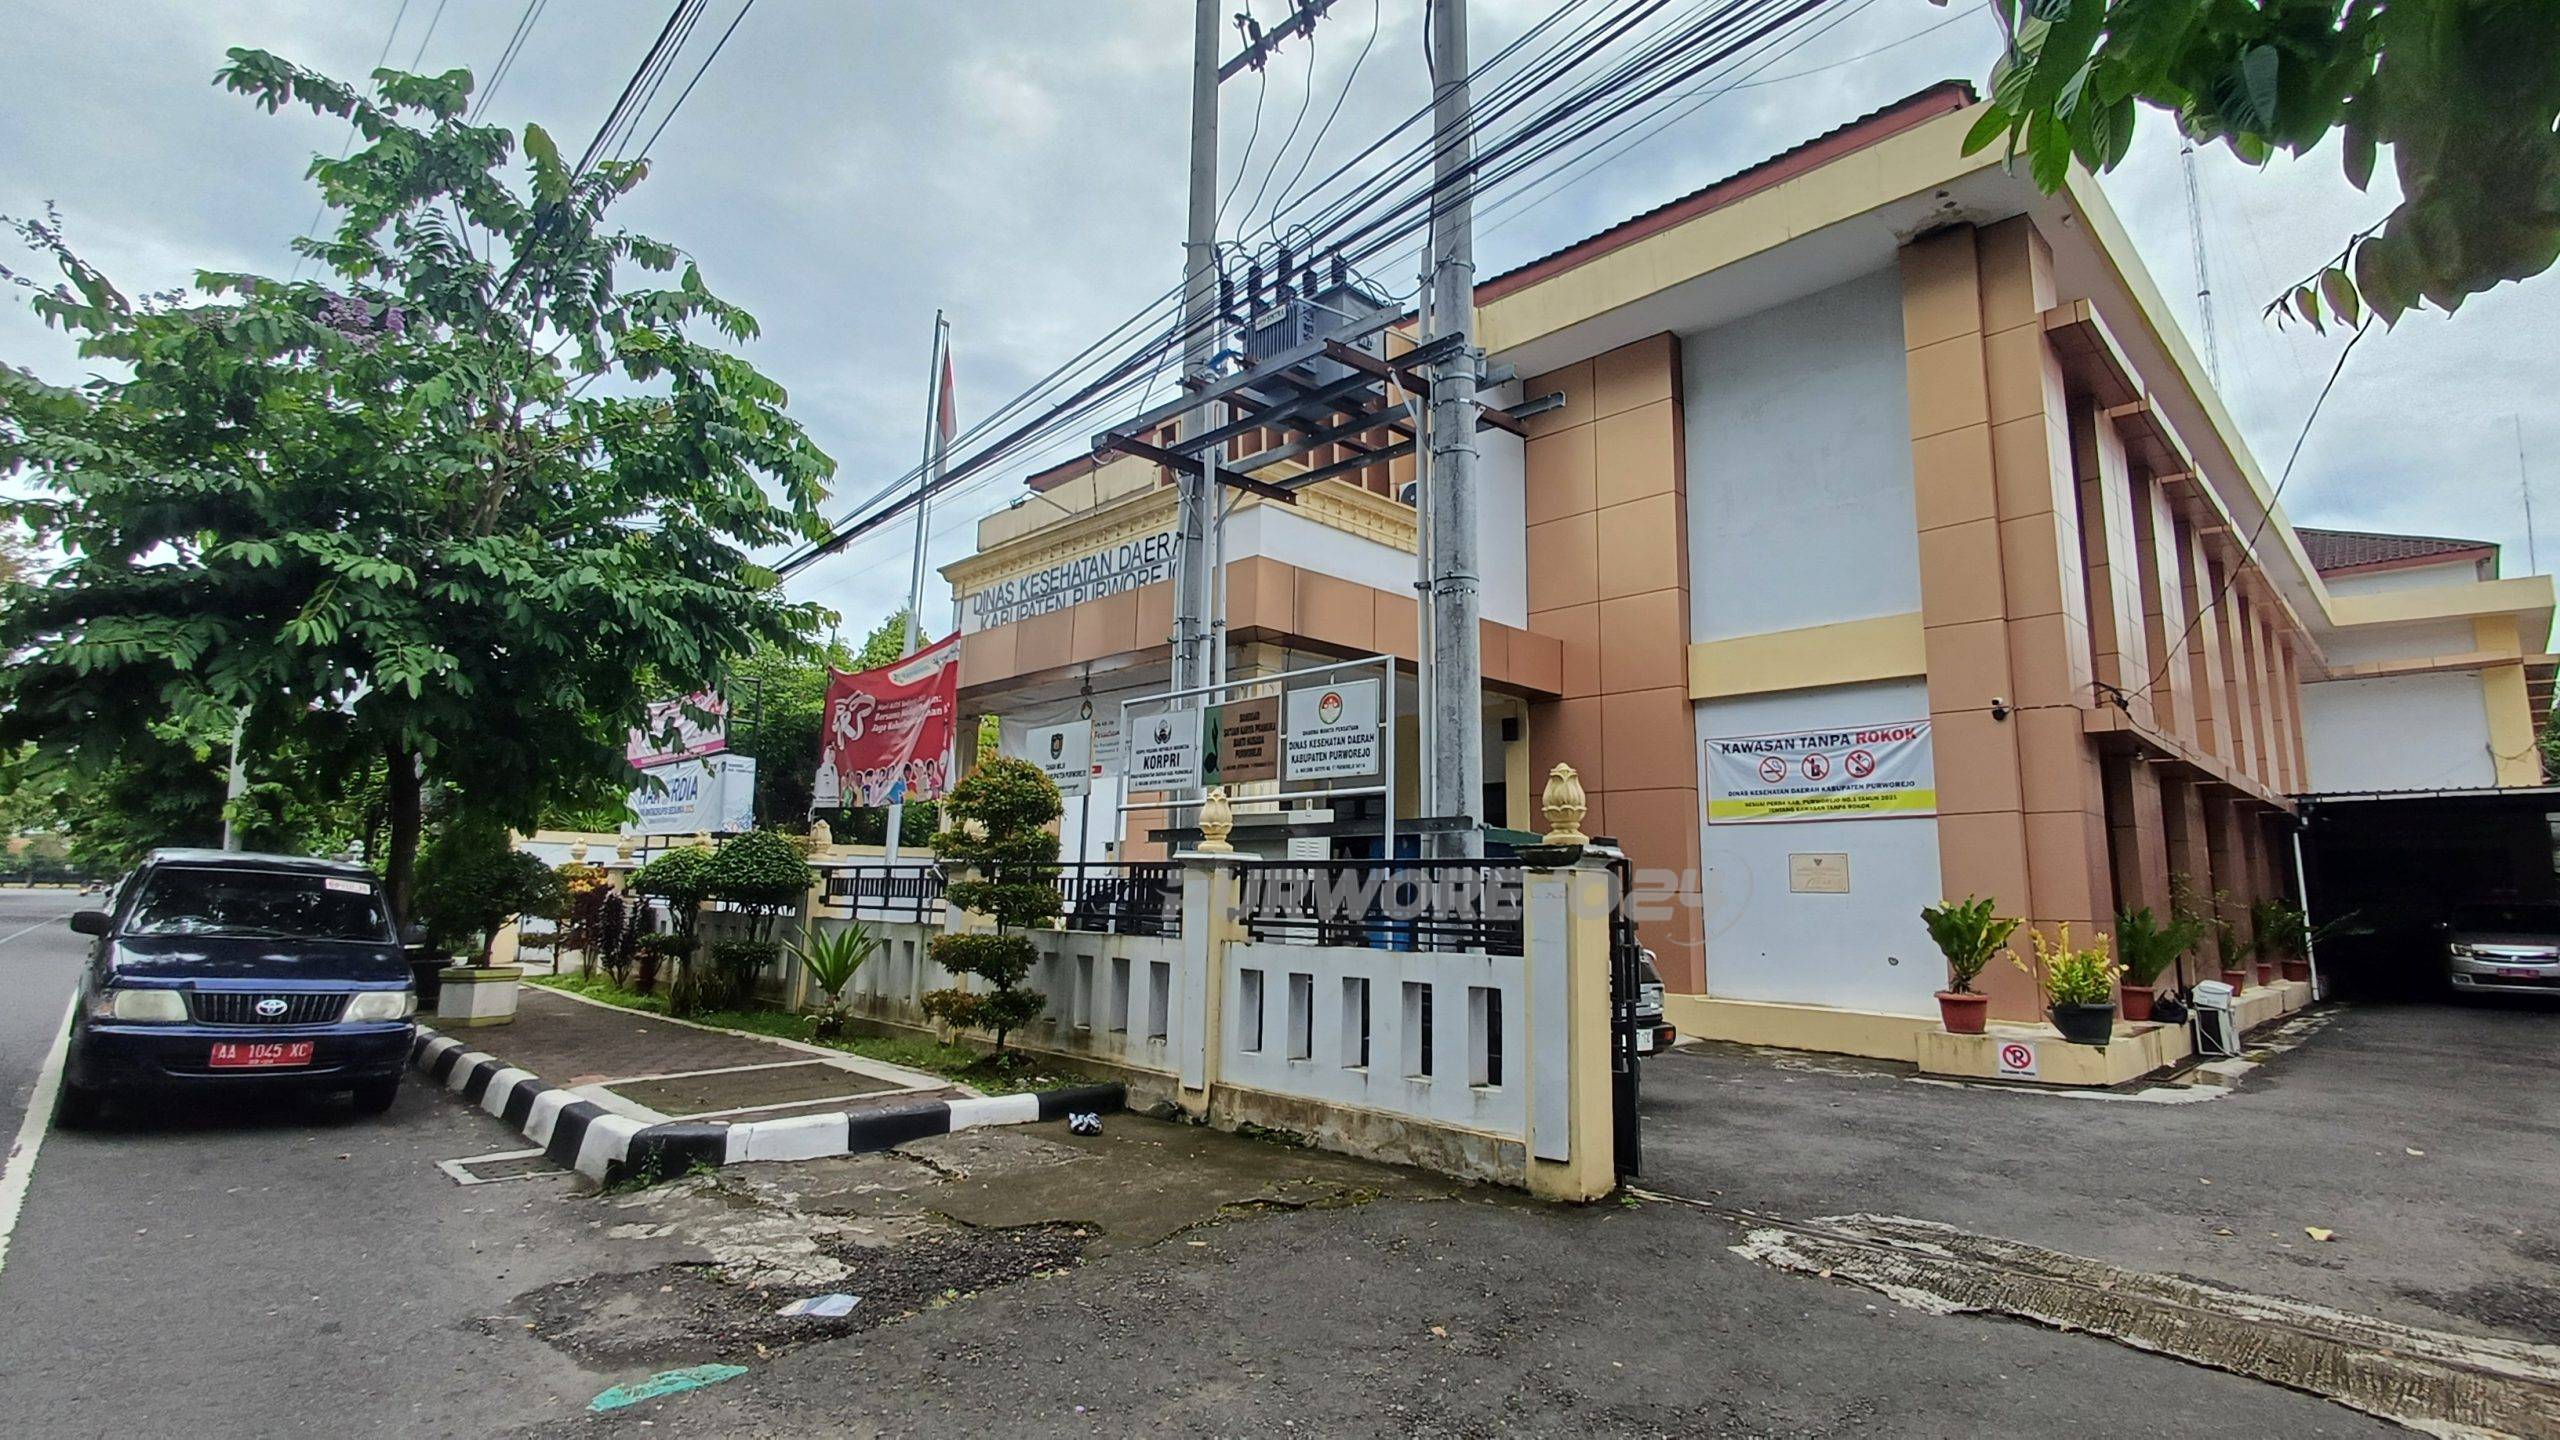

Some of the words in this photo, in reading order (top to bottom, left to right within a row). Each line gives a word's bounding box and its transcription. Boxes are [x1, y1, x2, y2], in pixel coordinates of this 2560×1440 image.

[973, 581, 1014, 614] DINAS
[1020, 550, 1113, 598] KESEHATAN
[981, 597, 1067, 631] KABUPATEN
[1289, 740, 1308, 751] DINAS
[1309, 735, 1346, 749] KESEHATAN
[1347, 733, 1375, 745] DAERAH
[1721, 738, 1795, 755] KAWASAN
[1800, 734, 1851, 749] TANPA
[1855, 727, 1917, 745] ROKOK
[1143, 752, 1180, 770] KORPRI
[1291, 751, 1327, 764] KABUPATEN
[1329, 747, 1371, 760] PURWOREJO
[1750, 788, 1789, 796] KESEHATAN
[1791, 786, 1820, 794] DAERAH
[1821, 783, 1864, 793] KABUPATEN
[1865, 780, 1916, 790] PURWOREJO
[218, 1044, 236, 1059] AA
[249, 1044, 282, 1058] 1045
[289, 1043, 309, 1057] XC
